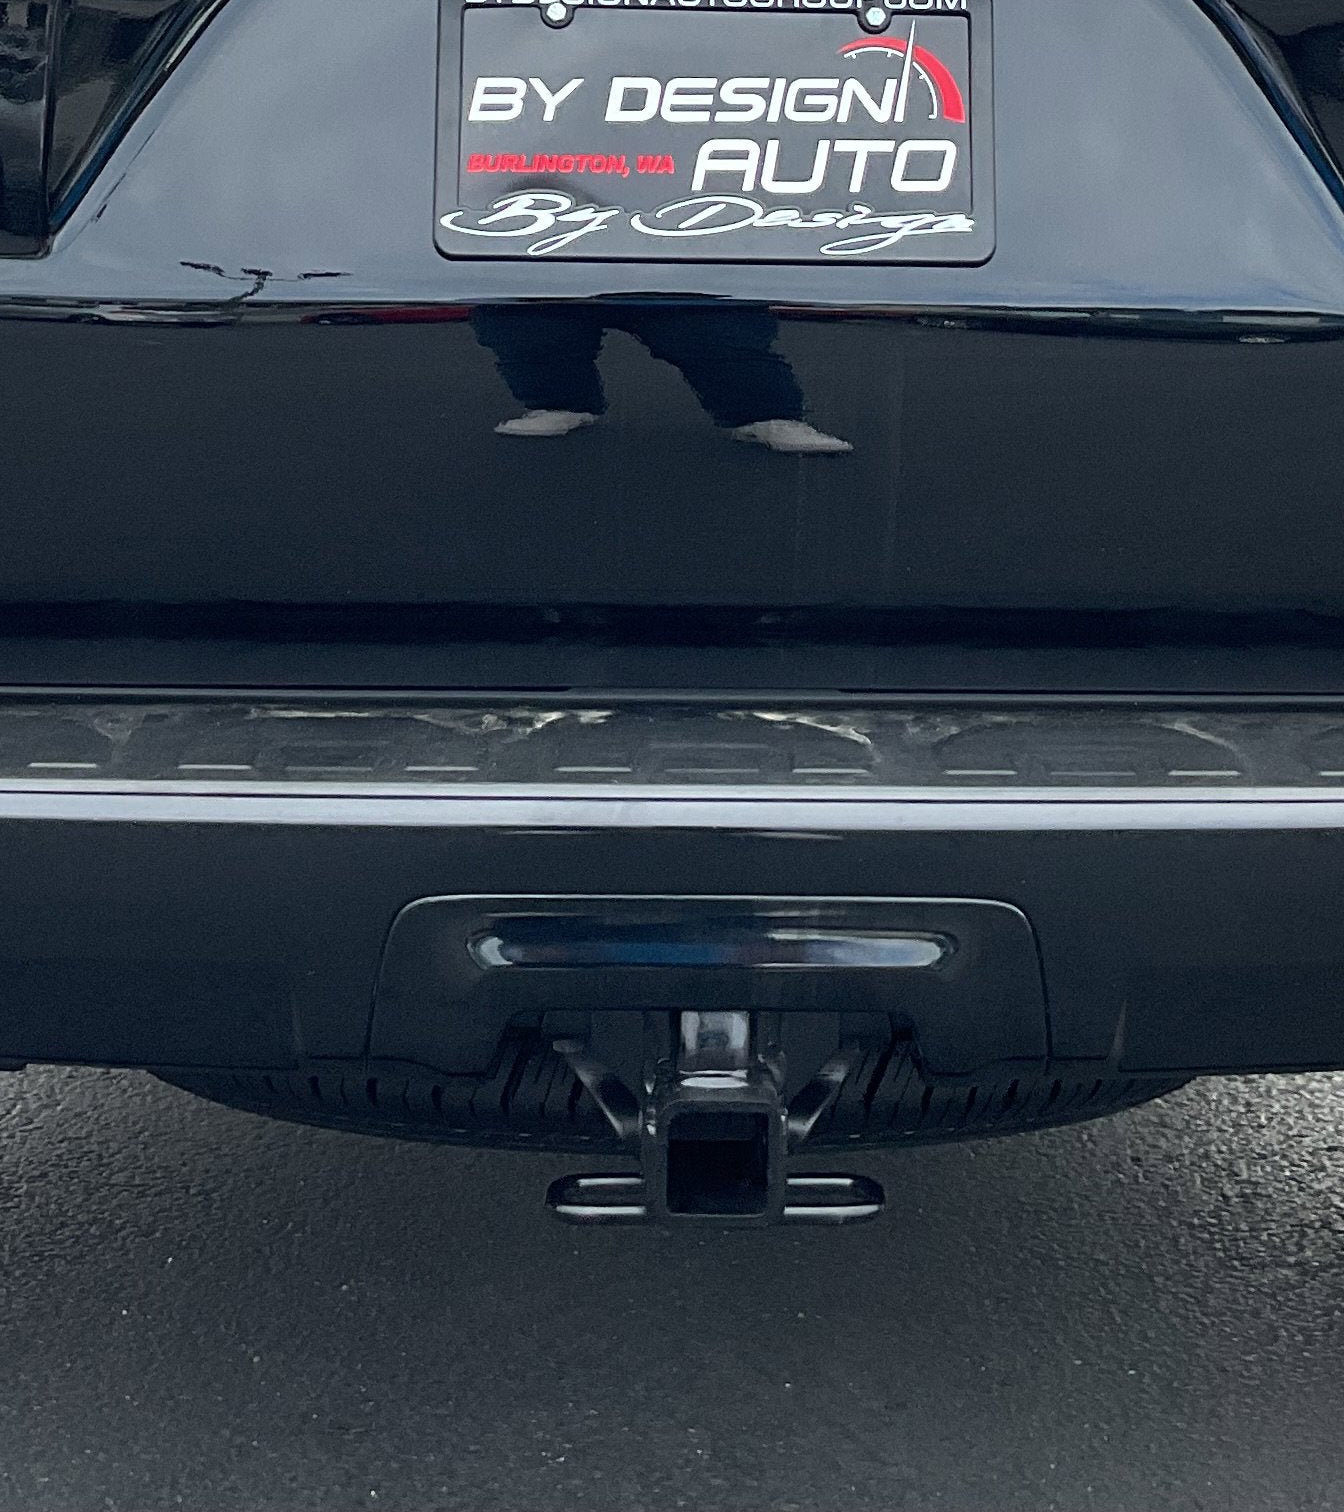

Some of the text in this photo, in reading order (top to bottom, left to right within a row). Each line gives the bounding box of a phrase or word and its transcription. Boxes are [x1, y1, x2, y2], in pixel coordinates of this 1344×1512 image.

[467, 76, 906, 124] BY DESIGN
[466, 153, 676, 178] BURLINGTON, WA
[690, 138, 958, 195] AUTO
[440, 191, 976, 257] By Design
